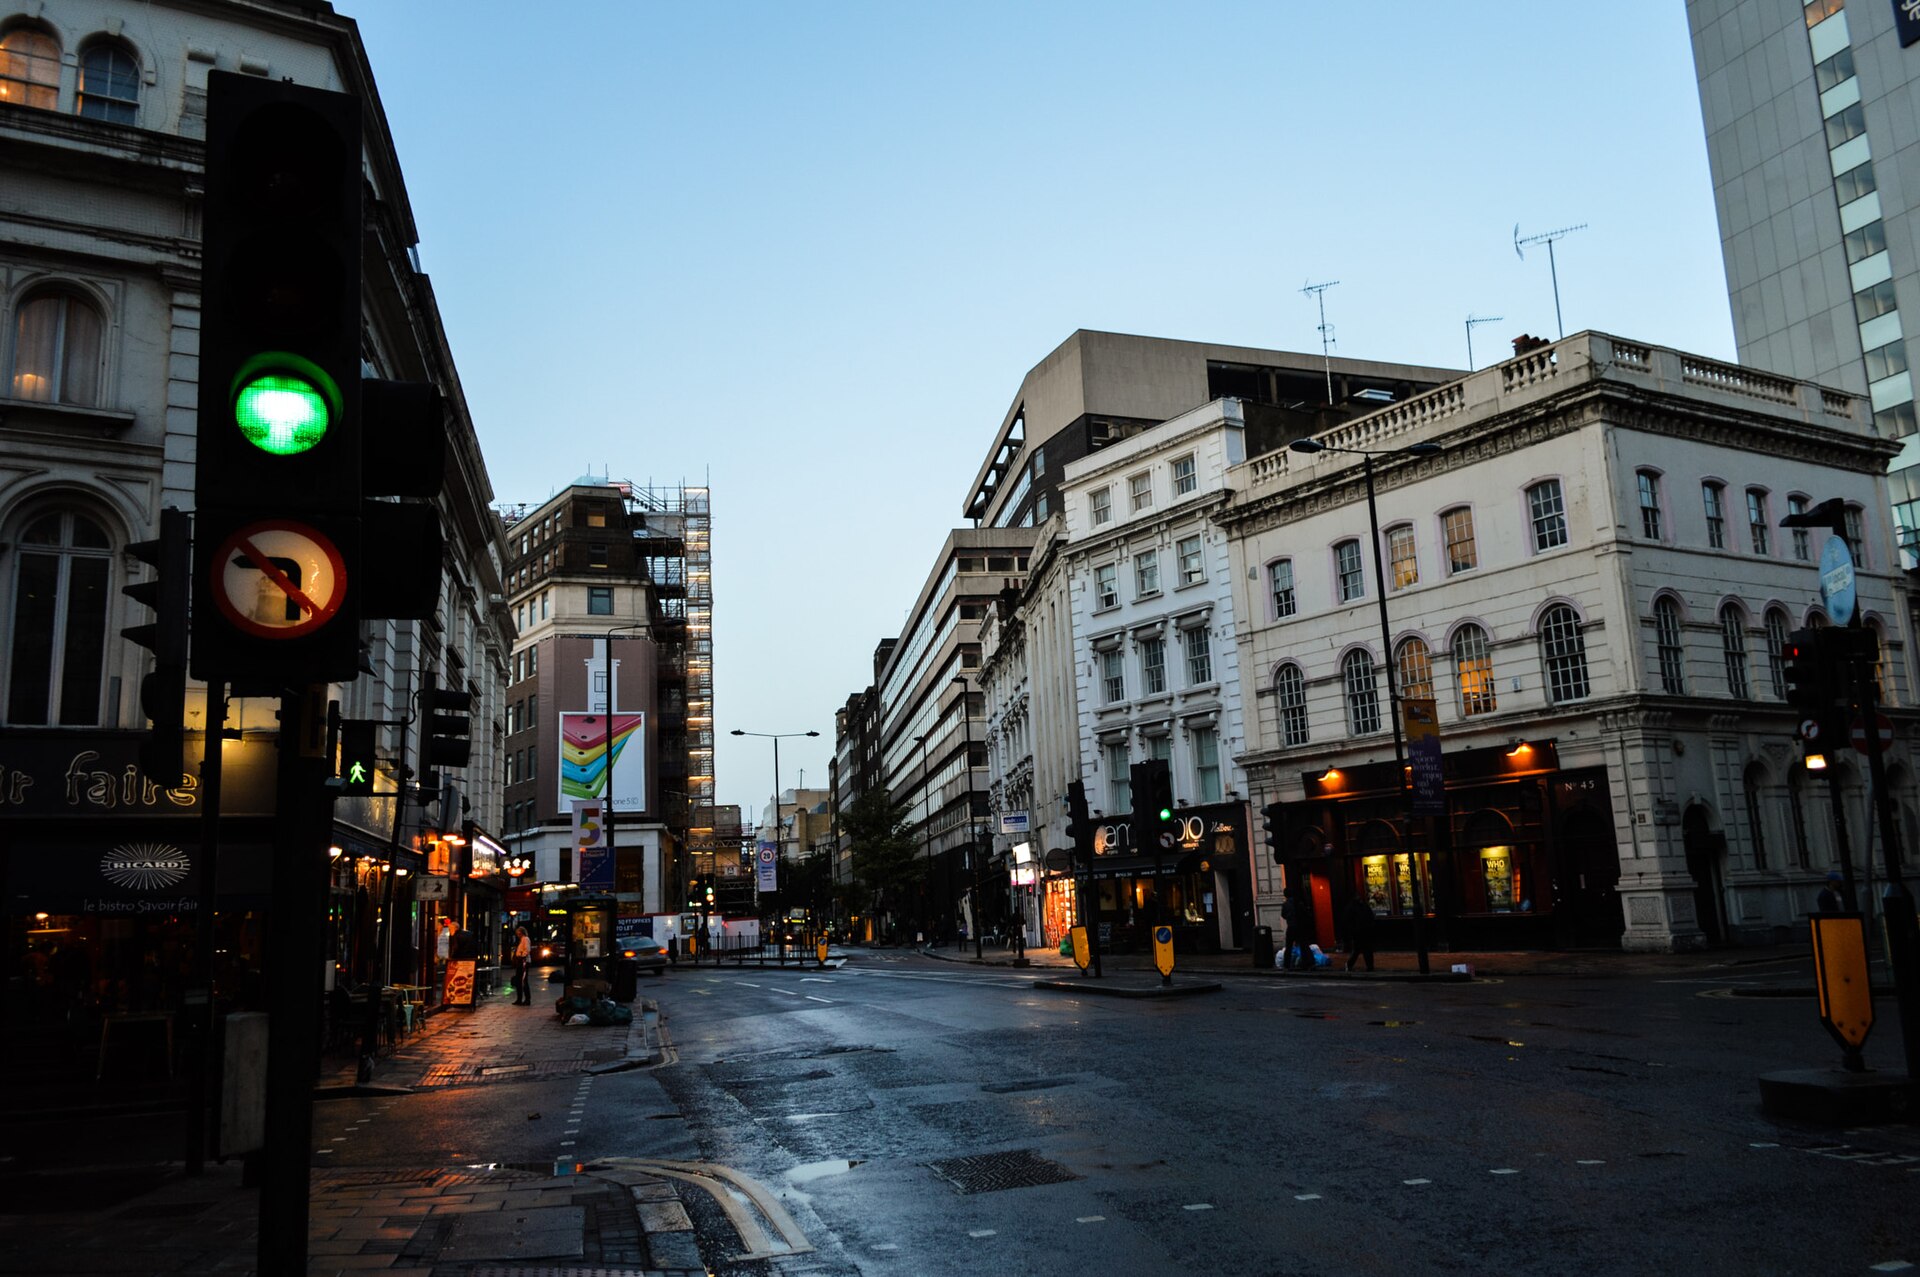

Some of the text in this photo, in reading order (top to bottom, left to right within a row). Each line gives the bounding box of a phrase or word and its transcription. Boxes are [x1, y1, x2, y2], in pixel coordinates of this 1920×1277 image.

[1580, 779, 1595, 790] 45
[579, 808, 601, 846] 5
[763, 852, 771, 860] 20
[113, 861, 179, 869] RICARD
[1399, 863, 1411, 872] WH
[1486, 859, 1505, 868] WHO
[83, 899, 96, 911] le
[100, 899, 134, 911] bistro
[137, 899, 175, 914] Savoir
